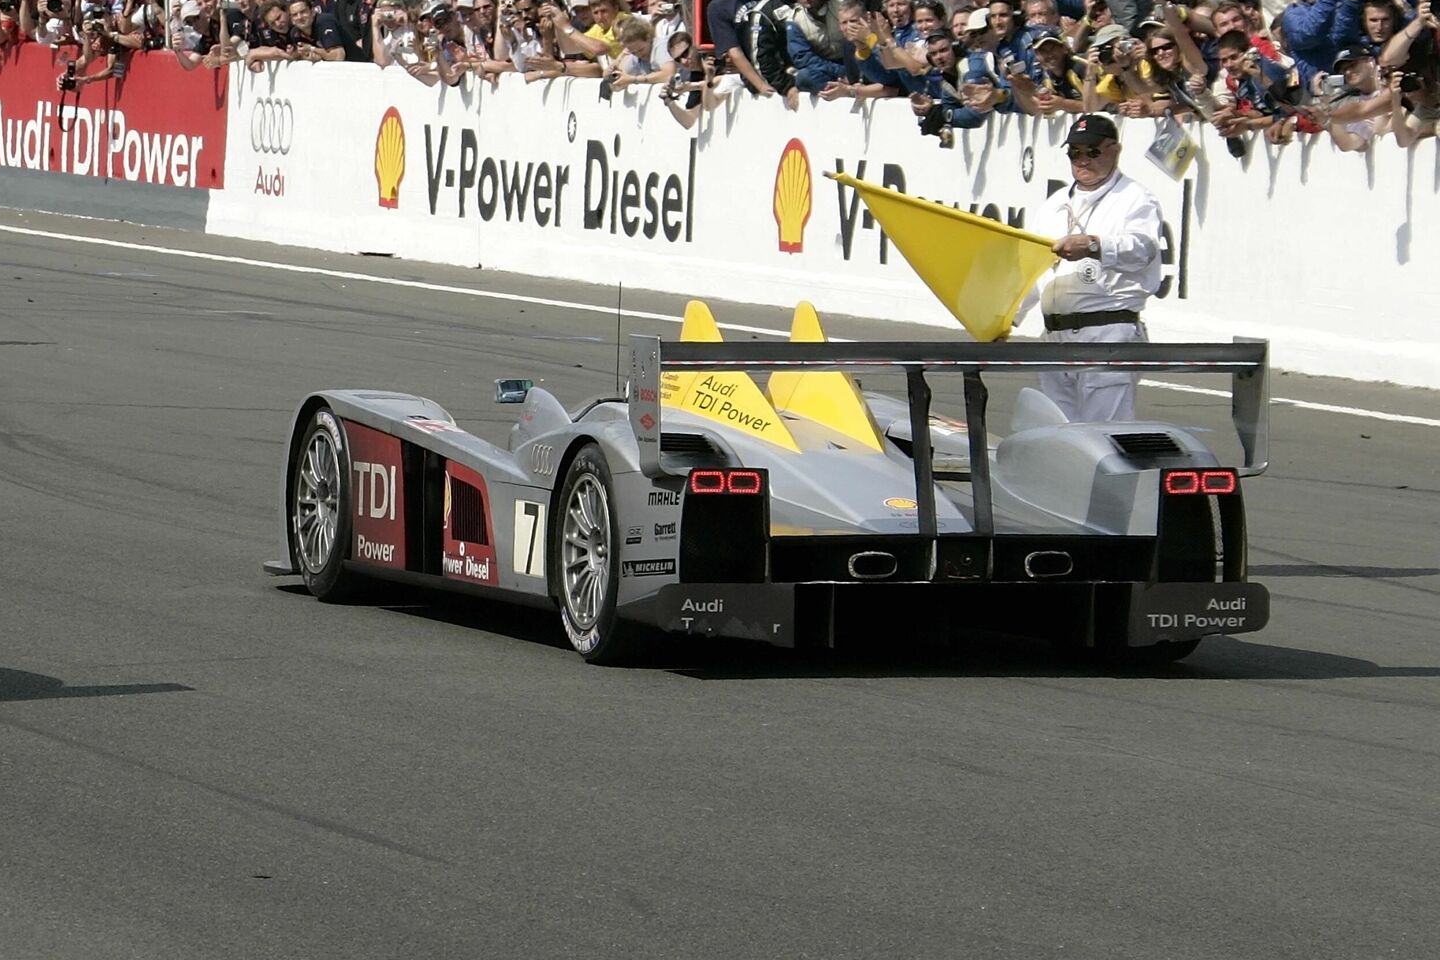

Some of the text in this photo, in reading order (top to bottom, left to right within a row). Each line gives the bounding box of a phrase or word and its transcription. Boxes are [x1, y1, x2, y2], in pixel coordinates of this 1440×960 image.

[57, 104, 100, 177] TDI
[107, 109, 203, 188] Power
[254, 165, 284, 197] Audi
[424, 123, 698, 242] V-Power Diesel
[701, 375, 738, 398] Audi
[692, 390, 772, 432] TDI Power
[353, 460, 397, 521] TDI
[648, 492, 680, 506] MAHLE
[357, 534, 395, 563] Power
[523, 501, 540, 575] 7
[465, 555, 490, 580] Diesel
[635, 561, 674, 572] MICHELIN
[681, 598, 723, 612] Audi
[1207, 597, 1246, 611] Audi
[1147, 614, 1246, 628] TDI Power
